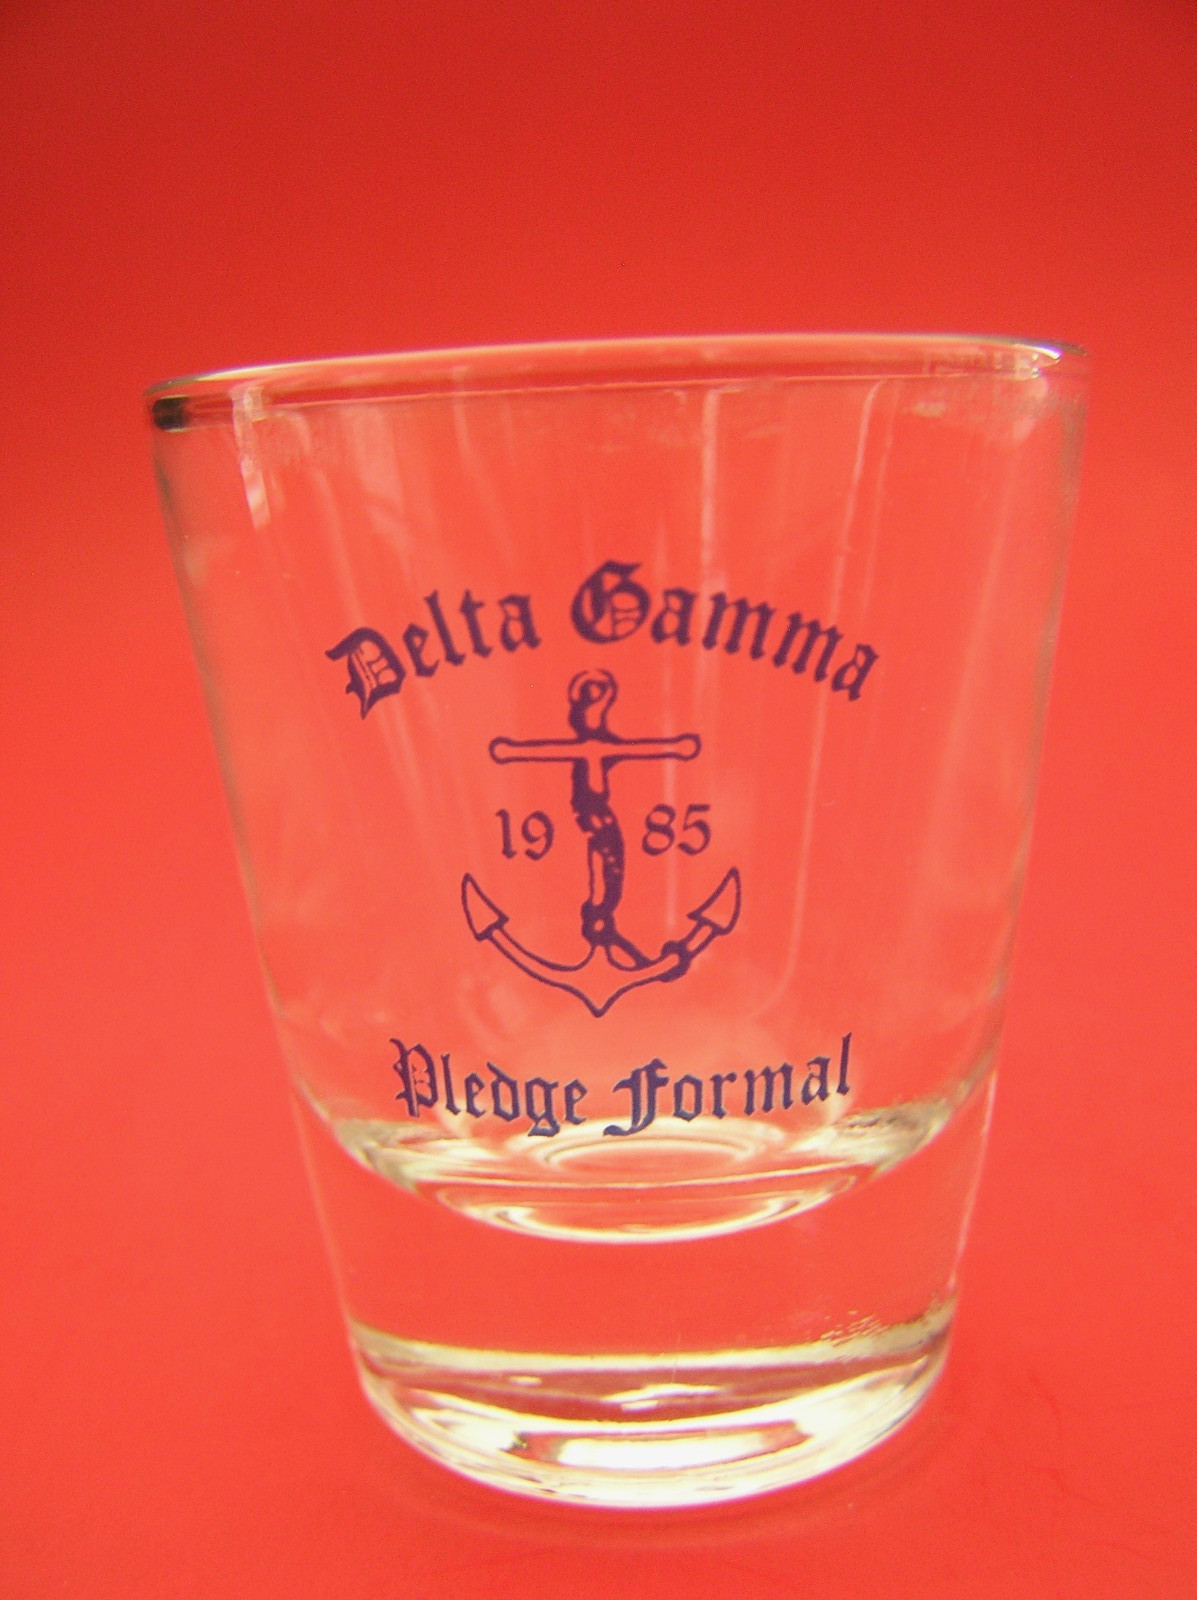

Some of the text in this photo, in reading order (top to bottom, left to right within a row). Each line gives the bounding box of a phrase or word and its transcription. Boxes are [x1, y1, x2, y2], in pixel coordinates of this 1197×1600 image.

[325, 560, 879, 719] Delta Gamma
[496, 804, 711, 861] 19 85
[390, 1033, 852, 1138] Pledge Formal
